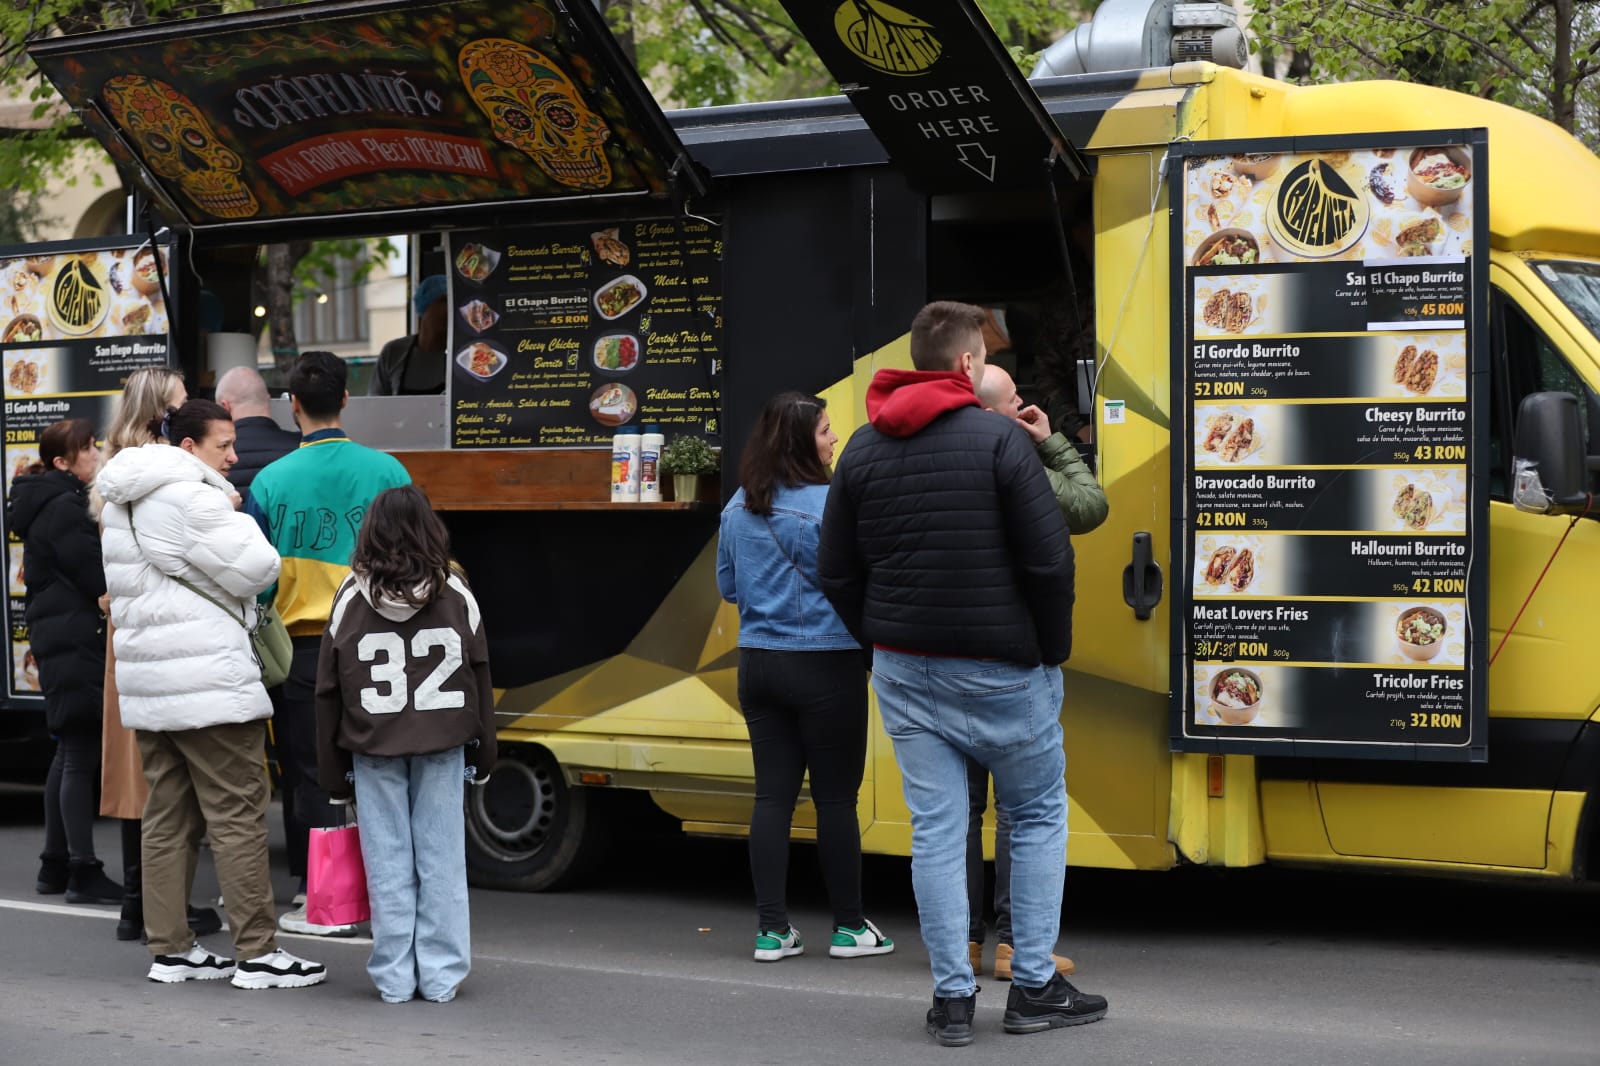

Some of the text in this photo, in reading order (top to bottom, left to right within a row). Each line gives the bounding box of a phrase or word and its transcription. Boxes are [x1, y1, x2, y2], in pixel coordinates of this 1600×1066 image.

[888, 85, 990, 111] ORDER
[917, 115, 1000, 139] HERE
[408, 136, 489, 173] MEXICAN!
[634, 223, 647, 237] El
[649, 223, 675, 239] Gordo
[507, 243, 582, 257] Bravocado Burrito
[654, 274, 679, 287] Meat
[1370, 271, 1464, 286] El Chapo Burrito
[505, 296, 588, 307] El Chapo Burrito
[1421, 303, 1464, 315] 45 RON
[550, 316, 563, 324] 45
[565, 315, 589, 324] RON
[517, 338, 581, 353] Cheesy Chicken
[647, 331, 679, 347] Cartofi
[95, 343, 167, 358] San Diego Burrito
[1194, 344, 1300, 359] El Gordo Burrito
[533, 356, 564, 369] Burrito
[646, 387, 688, 400] Halloumi
[1194, 382, 1268, 397] 52 RON 500g
[5, 401, 70, 414] El Gordo Burrito
[517, 399, 538, 408] Salsa
[539, 398, 548, 407] de
[1365, 407, 1466, 425] Cheesy Burrito
[5, 430, 36, 442] 52 RON
[1393, 445, 1466, 462] 350g 43 RON
[1195, 474, 1316, 489] Bravocado Burrito
[1196, 512, 1268, 528] 42 RON 330g
[1351, 540, 1465, 556] Halloumi Burrito
[1412, 579, 1431, 593] 42
[1433, 579, 1465, 593] RON
[1193, 605, 1309, 621] Meat Lovers Fries
[1239, 642, 1268, 657] RON
[1272, 649, 1290, 660] 300g
[358, 627, 465, 714] 32
[1373, 673, 1464, 690] Tricolor Fries
[1390, 713, 1462, 729] 210g 32 RON
